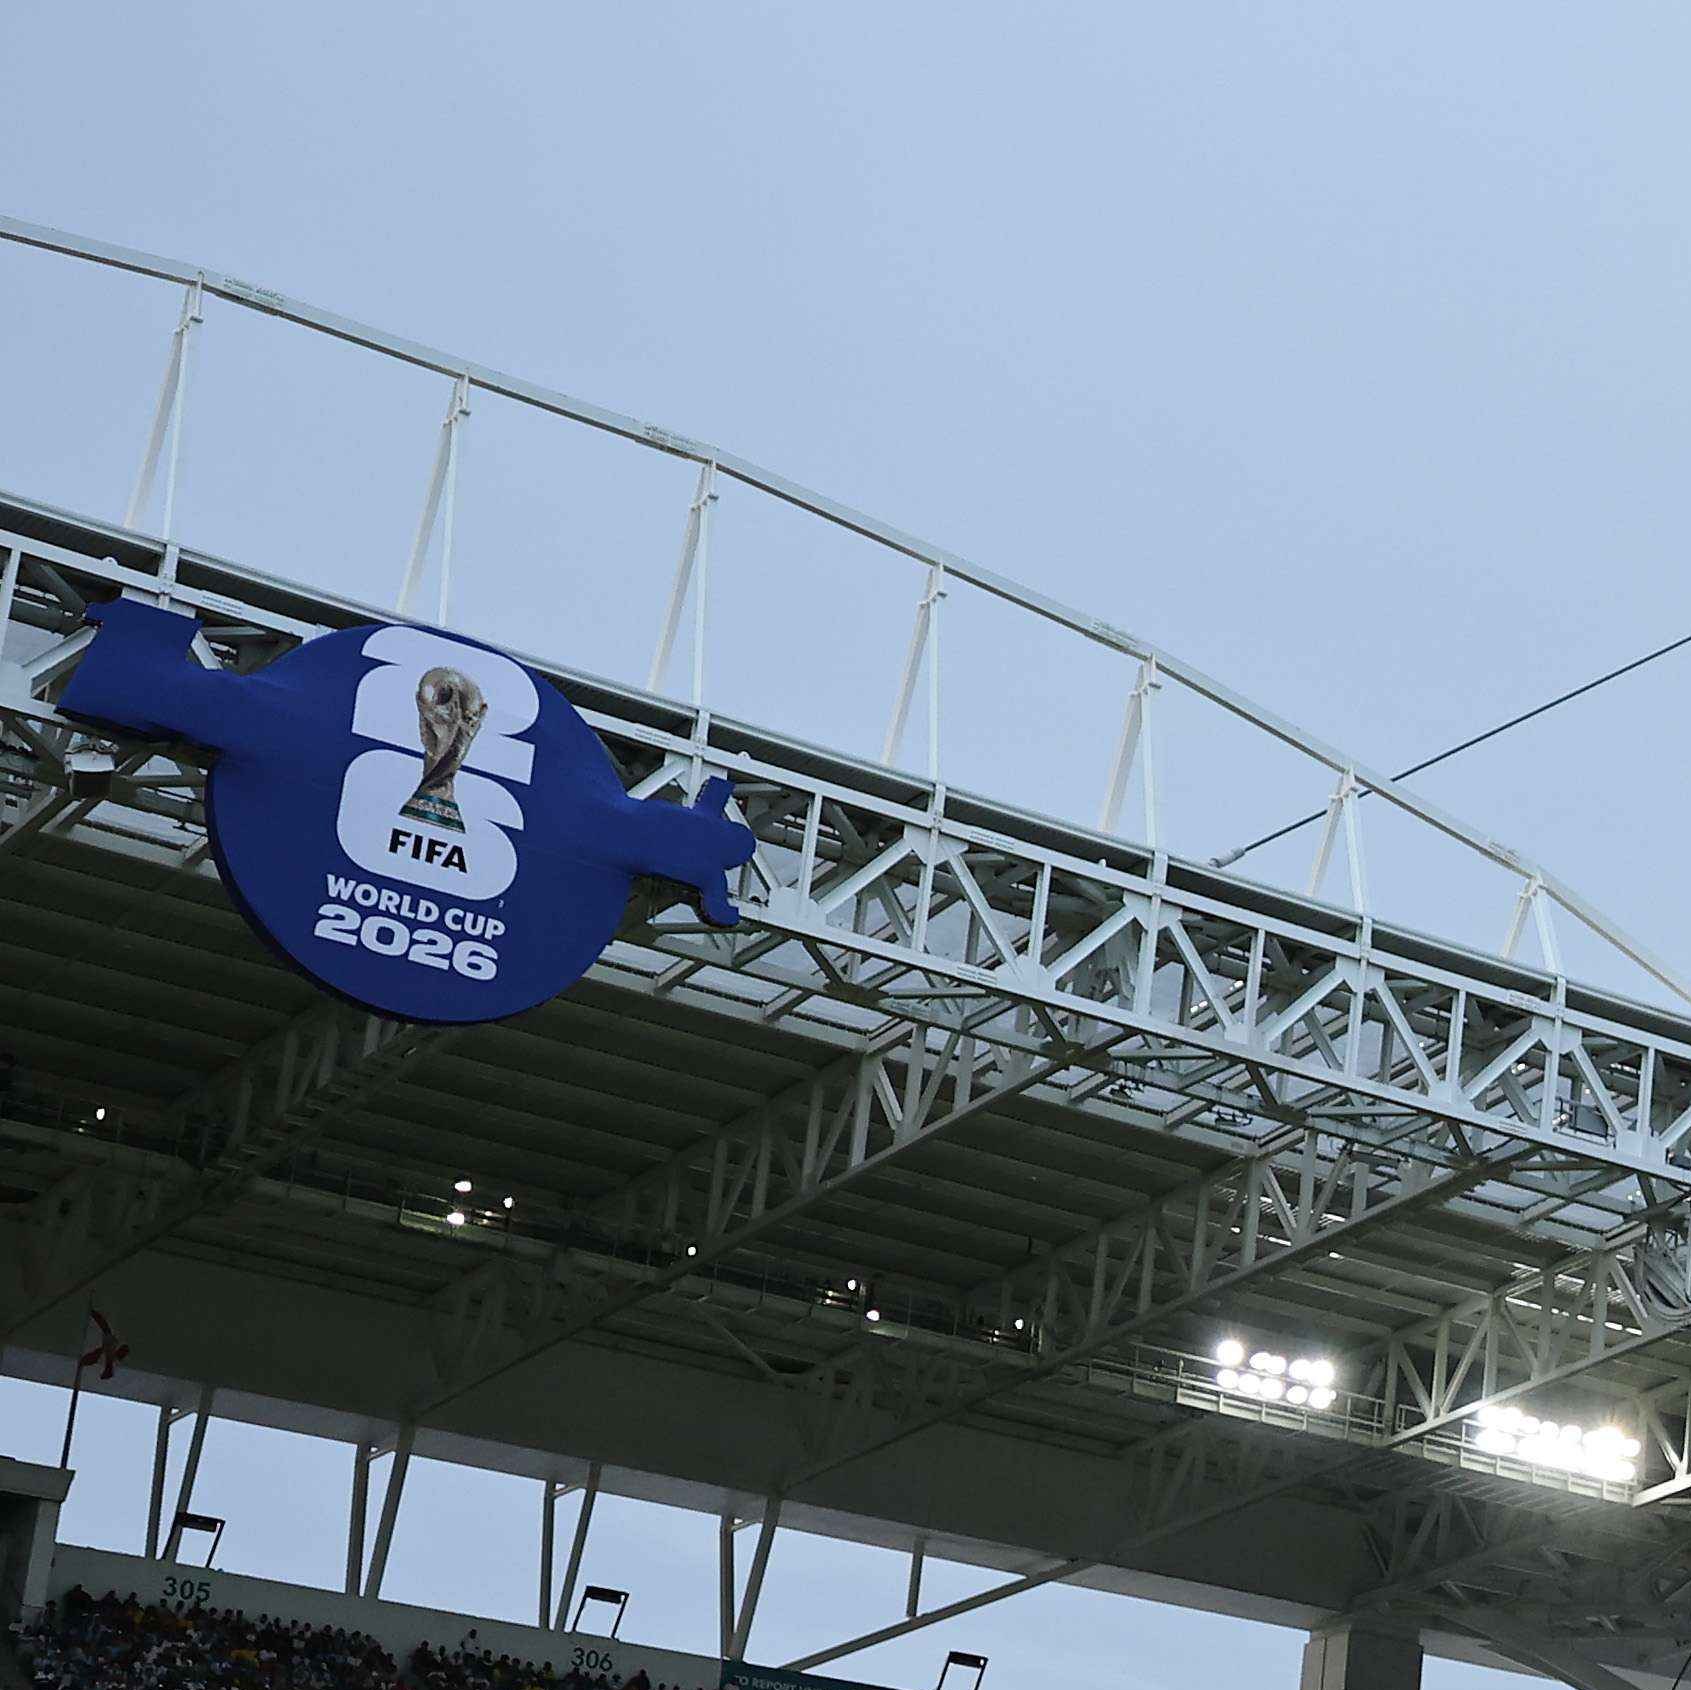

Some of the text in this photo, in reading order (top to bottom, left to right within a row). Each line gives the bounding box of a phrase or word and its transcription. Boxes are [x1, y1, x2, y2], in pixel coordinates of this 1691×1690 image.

[387, 828, 468, 874] FIFA
[326, 873, 506, 940] WORLD CUP
[313, 903, 499, 981] 2026
[163, 1577, 211, 1603] 305
[570, 1647, 613, 1672] 306
